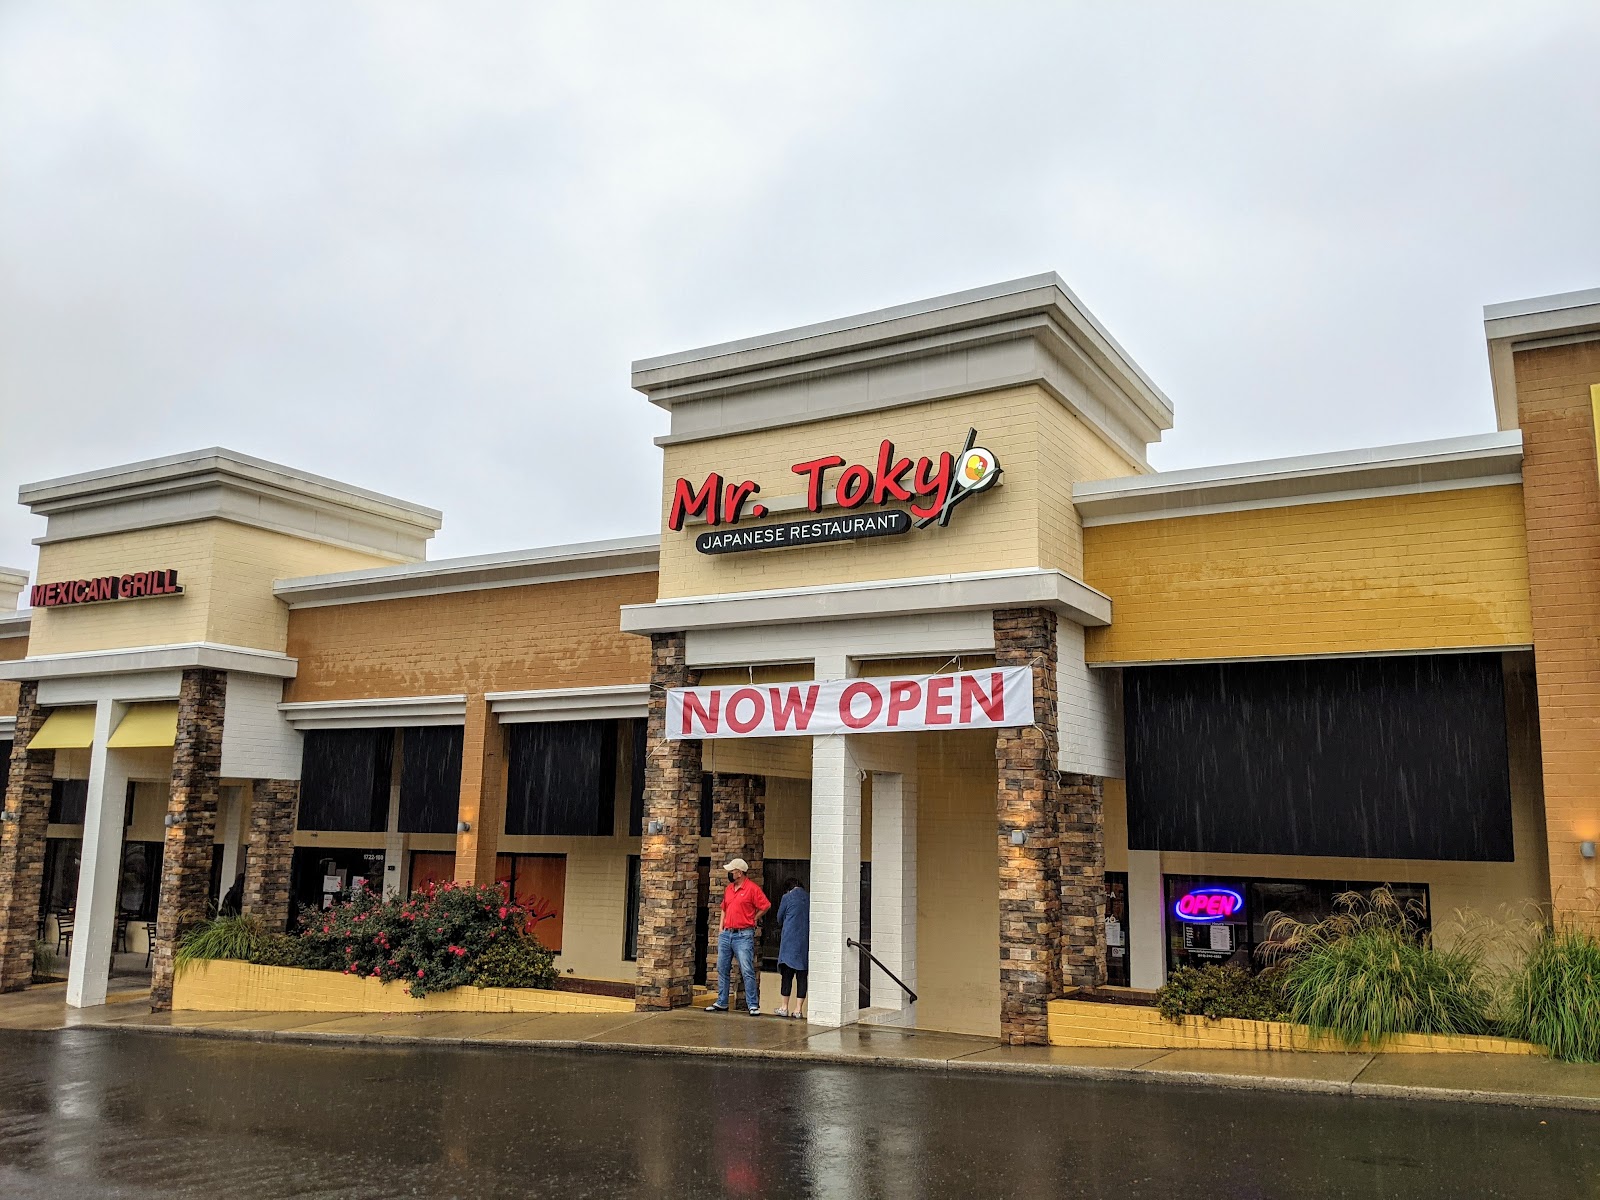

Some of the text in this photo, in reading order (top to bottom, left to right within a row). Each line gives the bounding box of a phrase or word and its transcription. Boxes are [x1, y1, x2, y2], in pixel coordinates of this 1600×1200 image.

[668, 472, 769, 531] Mr.
[702, 514, 900, 550] JAPANESE RESTAURANT
[30, 569, 178, 607] MEXICAN GRILL
[681, 672, 1006, 735] NOW OPEN
[1180, 894, 1235, 915] OPEN
